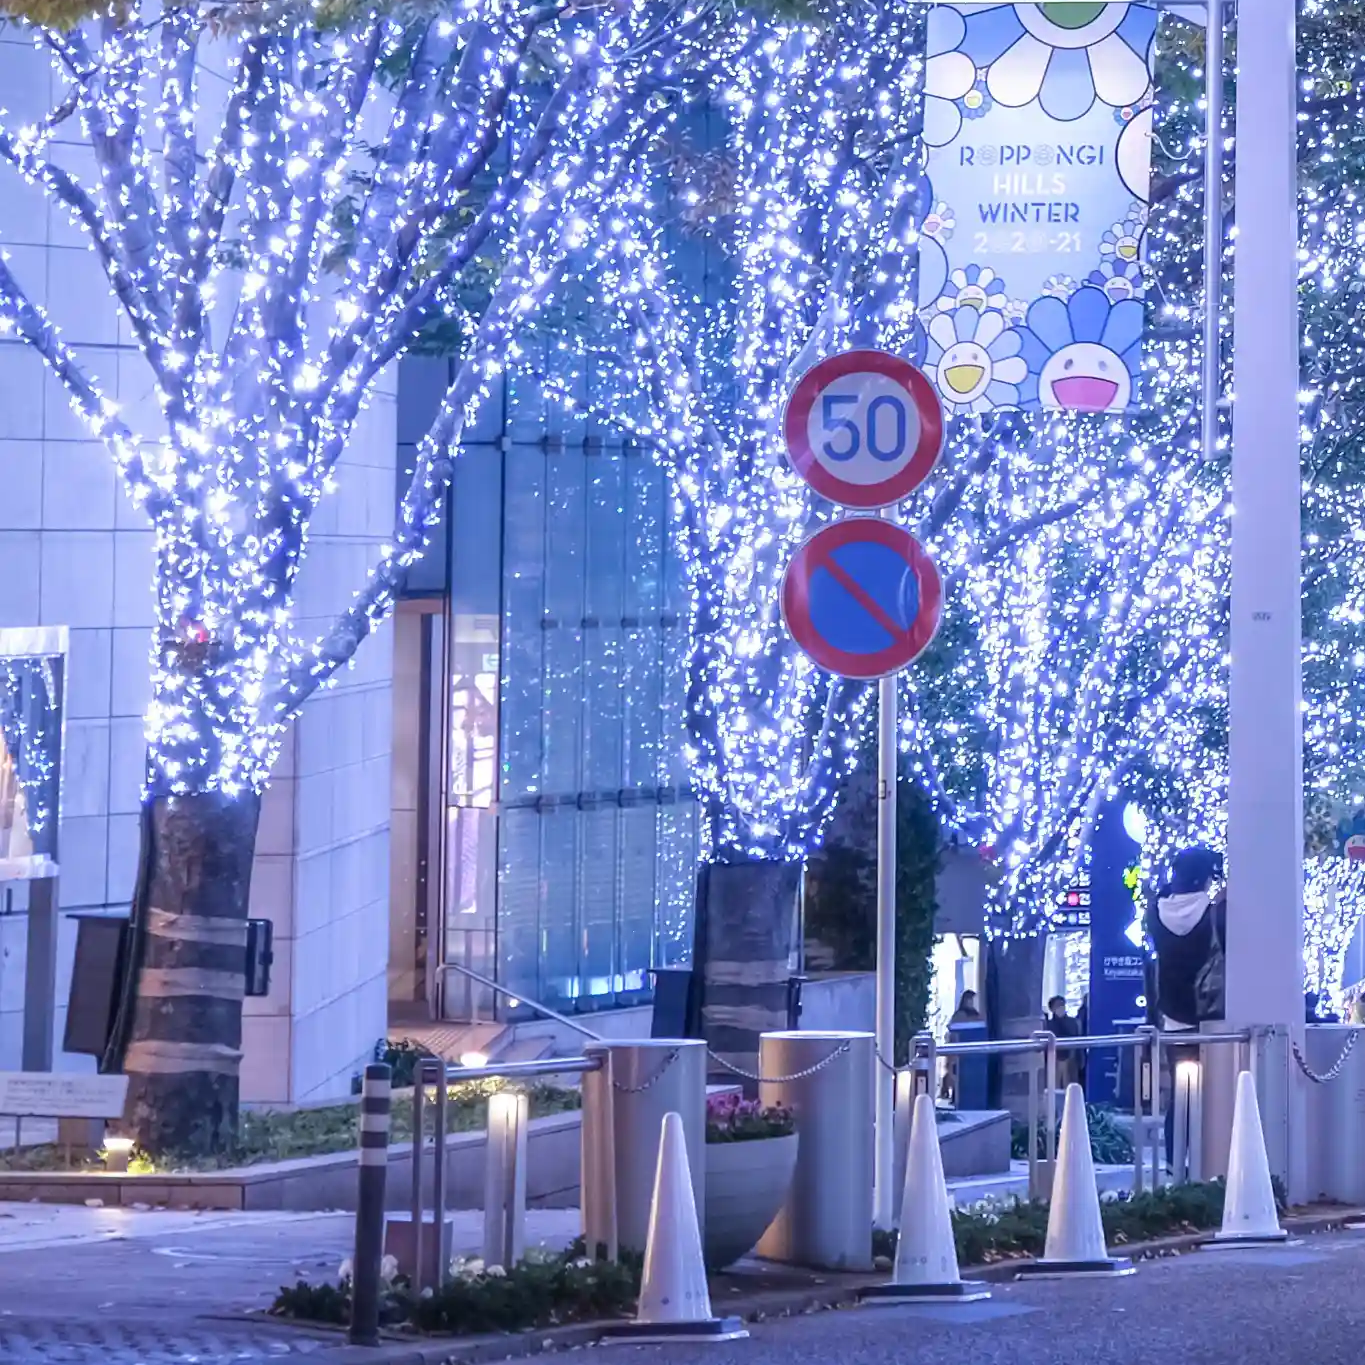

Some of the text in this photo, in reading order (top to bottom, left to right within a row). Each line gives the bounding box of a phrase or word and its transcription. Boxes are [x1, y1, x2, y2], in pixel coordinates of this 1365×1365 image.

[993, 173, 1066, 195] HILLS
[978, 202, 1080, 223] WINTER
[822, 395, 906, 462] 50
